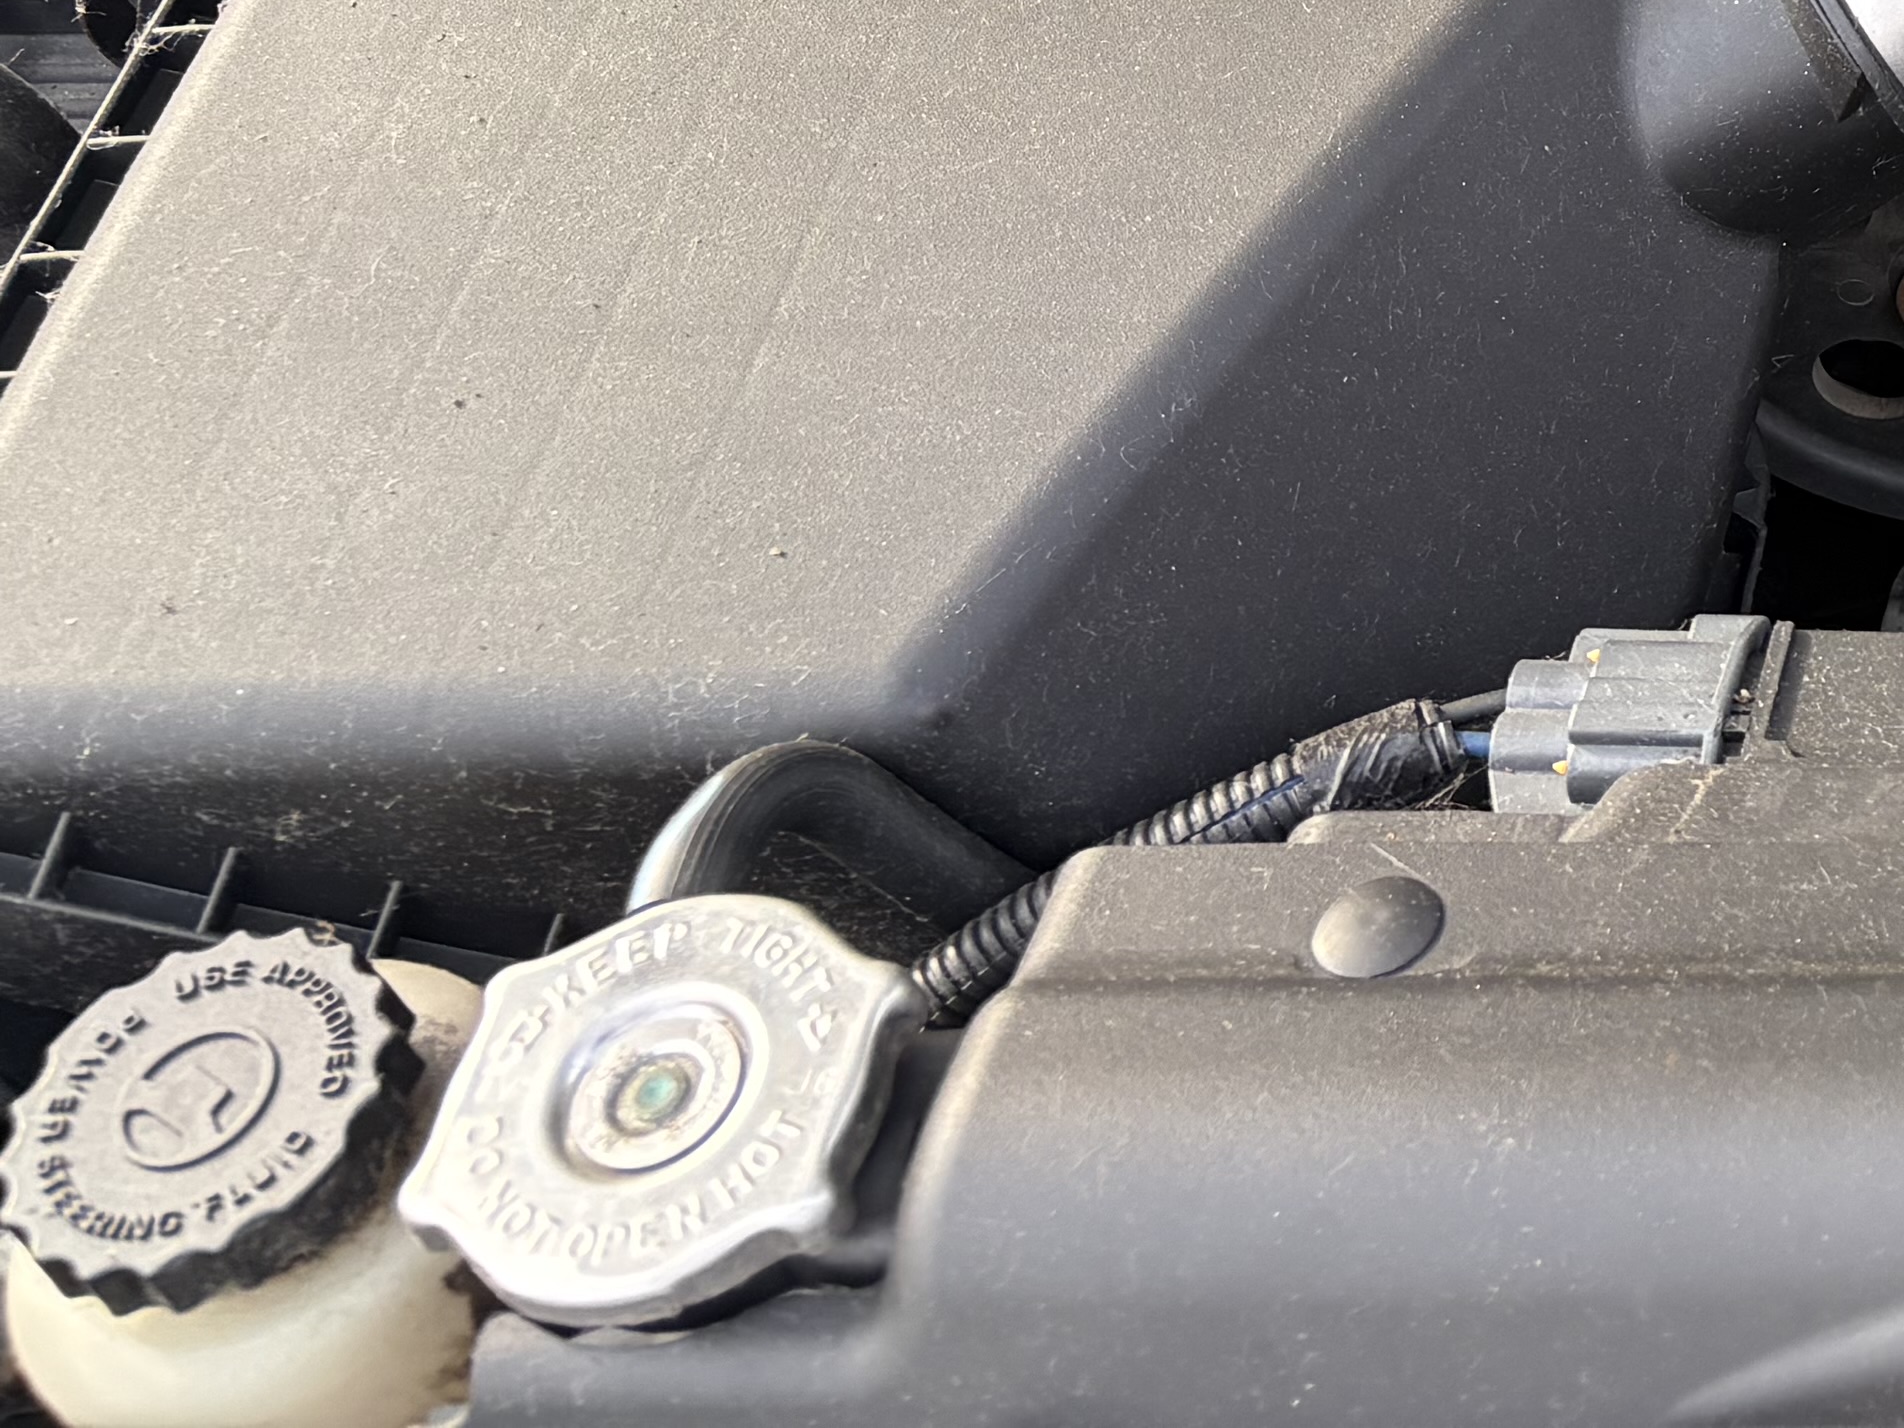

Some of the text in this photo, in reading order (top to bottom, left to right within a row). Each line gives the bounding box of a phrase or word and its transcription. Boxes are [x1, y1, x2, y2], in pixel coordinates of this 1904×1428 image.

[175, 960, 360, 1099] USE APPROVED
[718, 917, 836, 1001] TIGHT
[36, 1010, 316, 1242] POWER STEERING FLUID
[566, 1198, 709, 1265] OPEN
[707, 1107, 808, 1211] HOT
